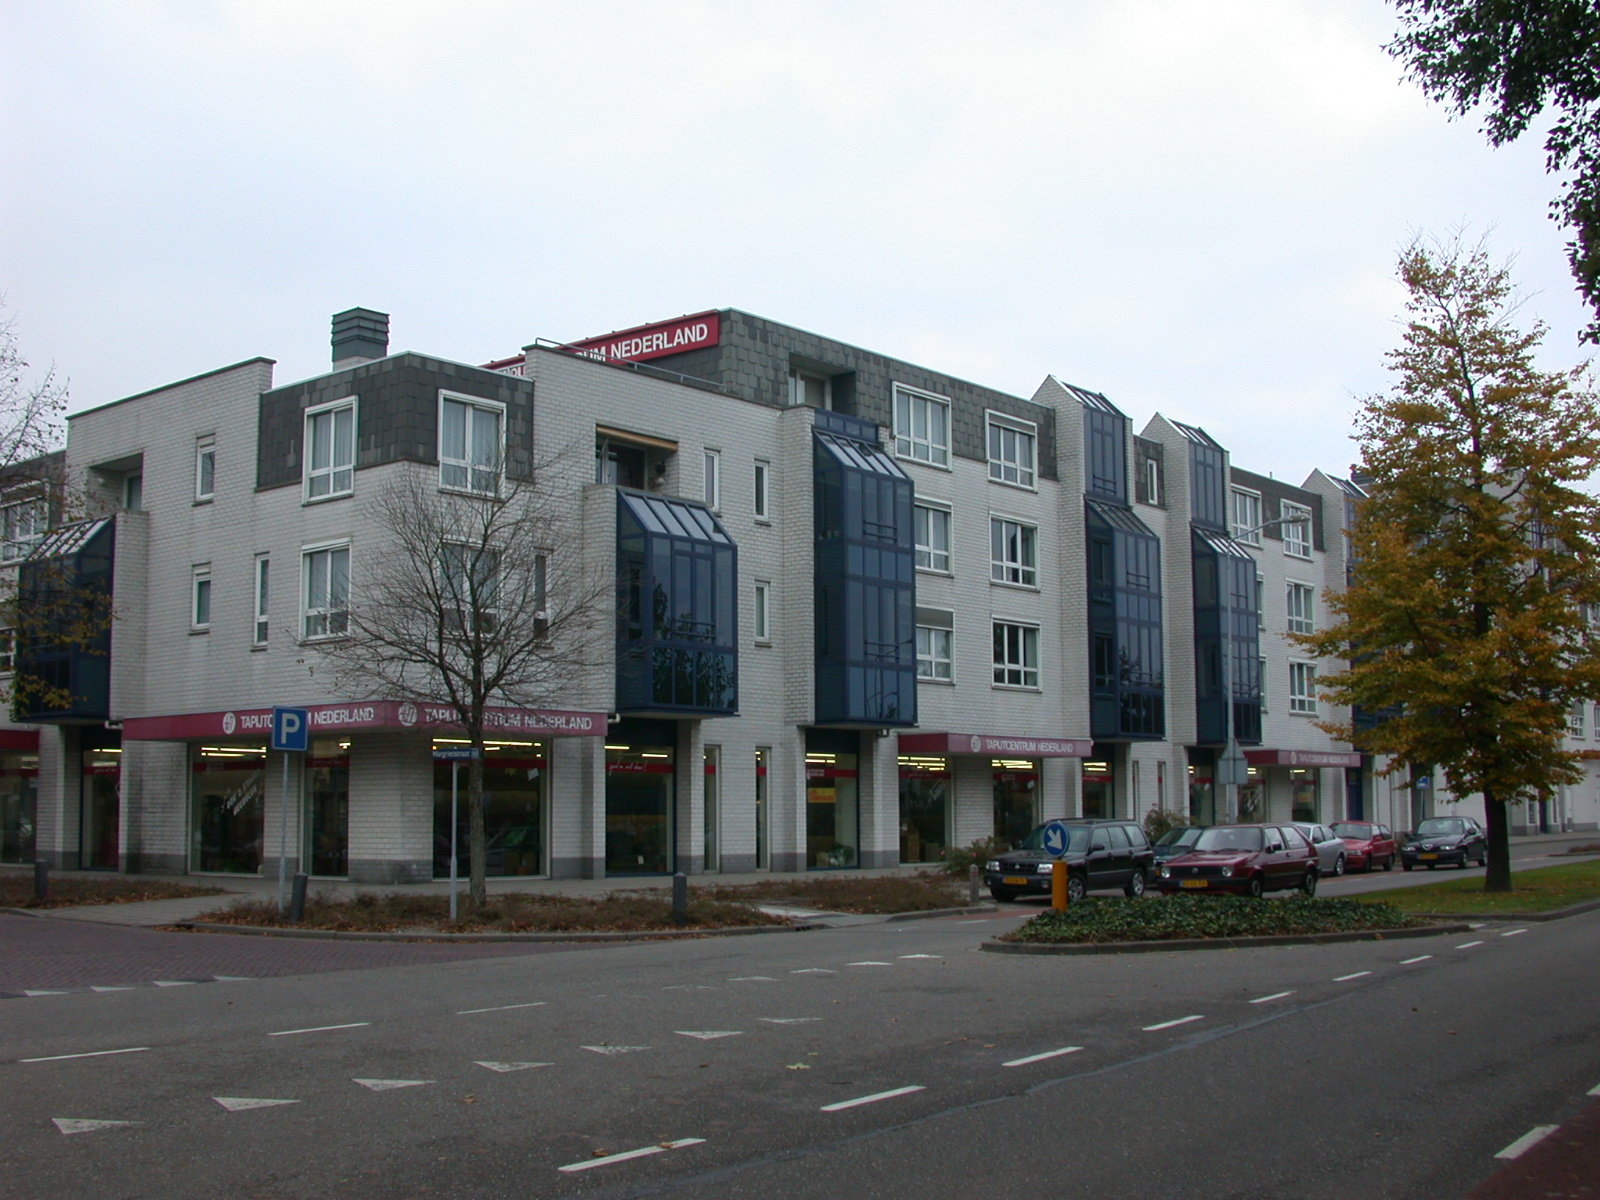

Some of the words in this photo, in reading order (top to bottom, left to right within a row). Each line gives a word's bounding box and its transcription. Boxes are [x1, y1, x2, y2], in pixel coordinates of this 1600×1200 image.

[611, 323, 708, 360] NEDERLAND
[314, 707, 374, 725] NEDERLAND
[281, 713, 300, 744] P
[1037, 742, 1073, 752] NEDERLAND
